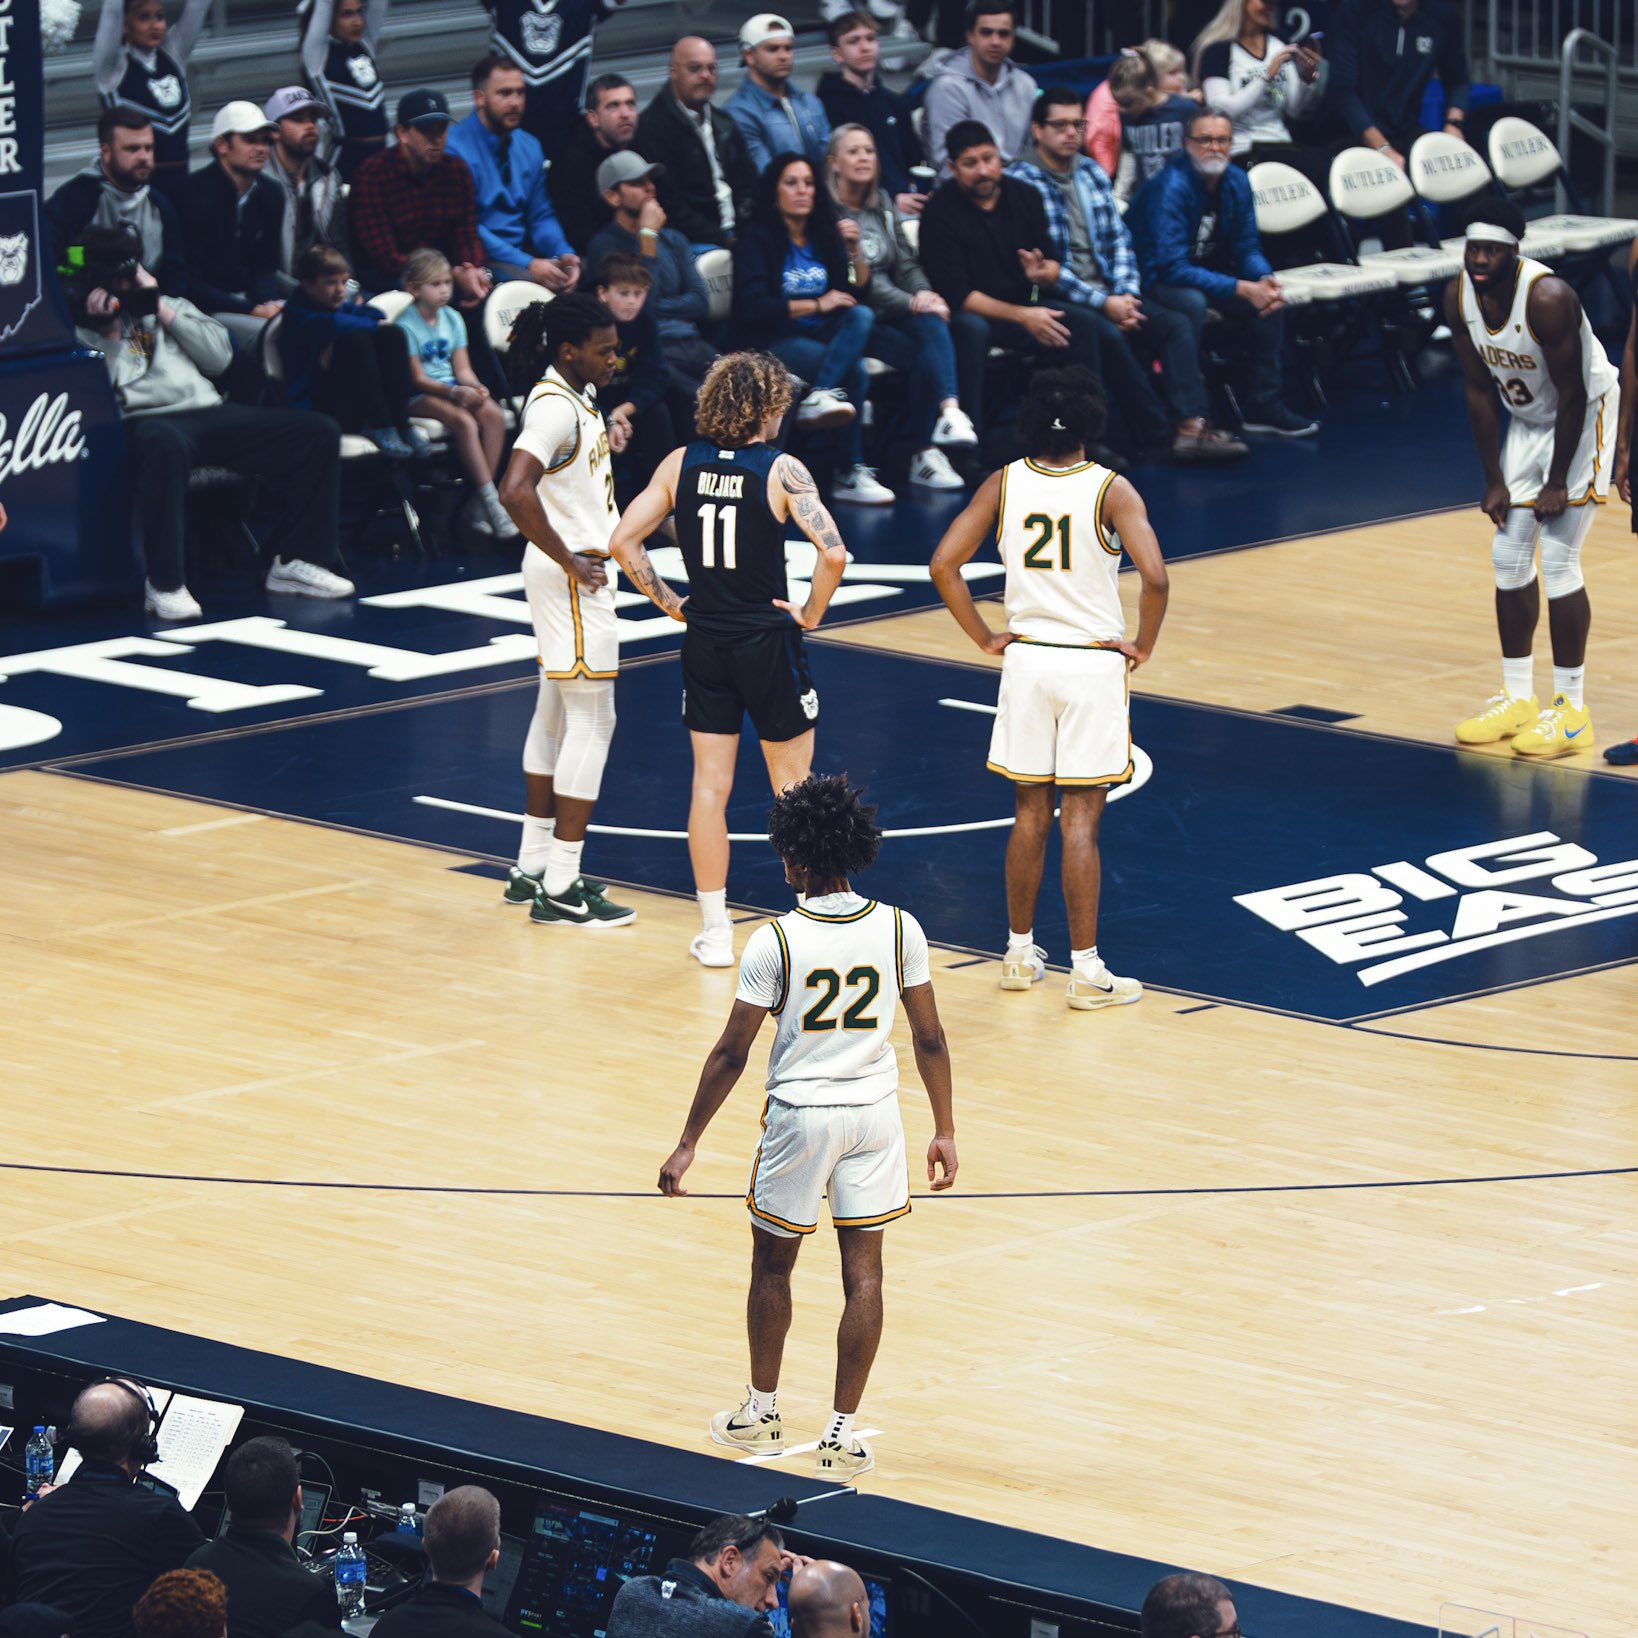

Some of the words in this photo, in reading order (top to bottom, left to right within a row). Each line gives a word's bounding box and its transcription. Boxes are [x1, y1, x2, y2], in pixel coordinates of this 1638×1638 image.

[0, 0, 23, 174] TLER
[696, 471, 744, 499] BIZJACK
[697, 503, 737, 569] 11
[1023, 512, 1072, 572] 21
[1232, 830, 1598, 931] BIG
[801, 964, 881, 1033] 22
